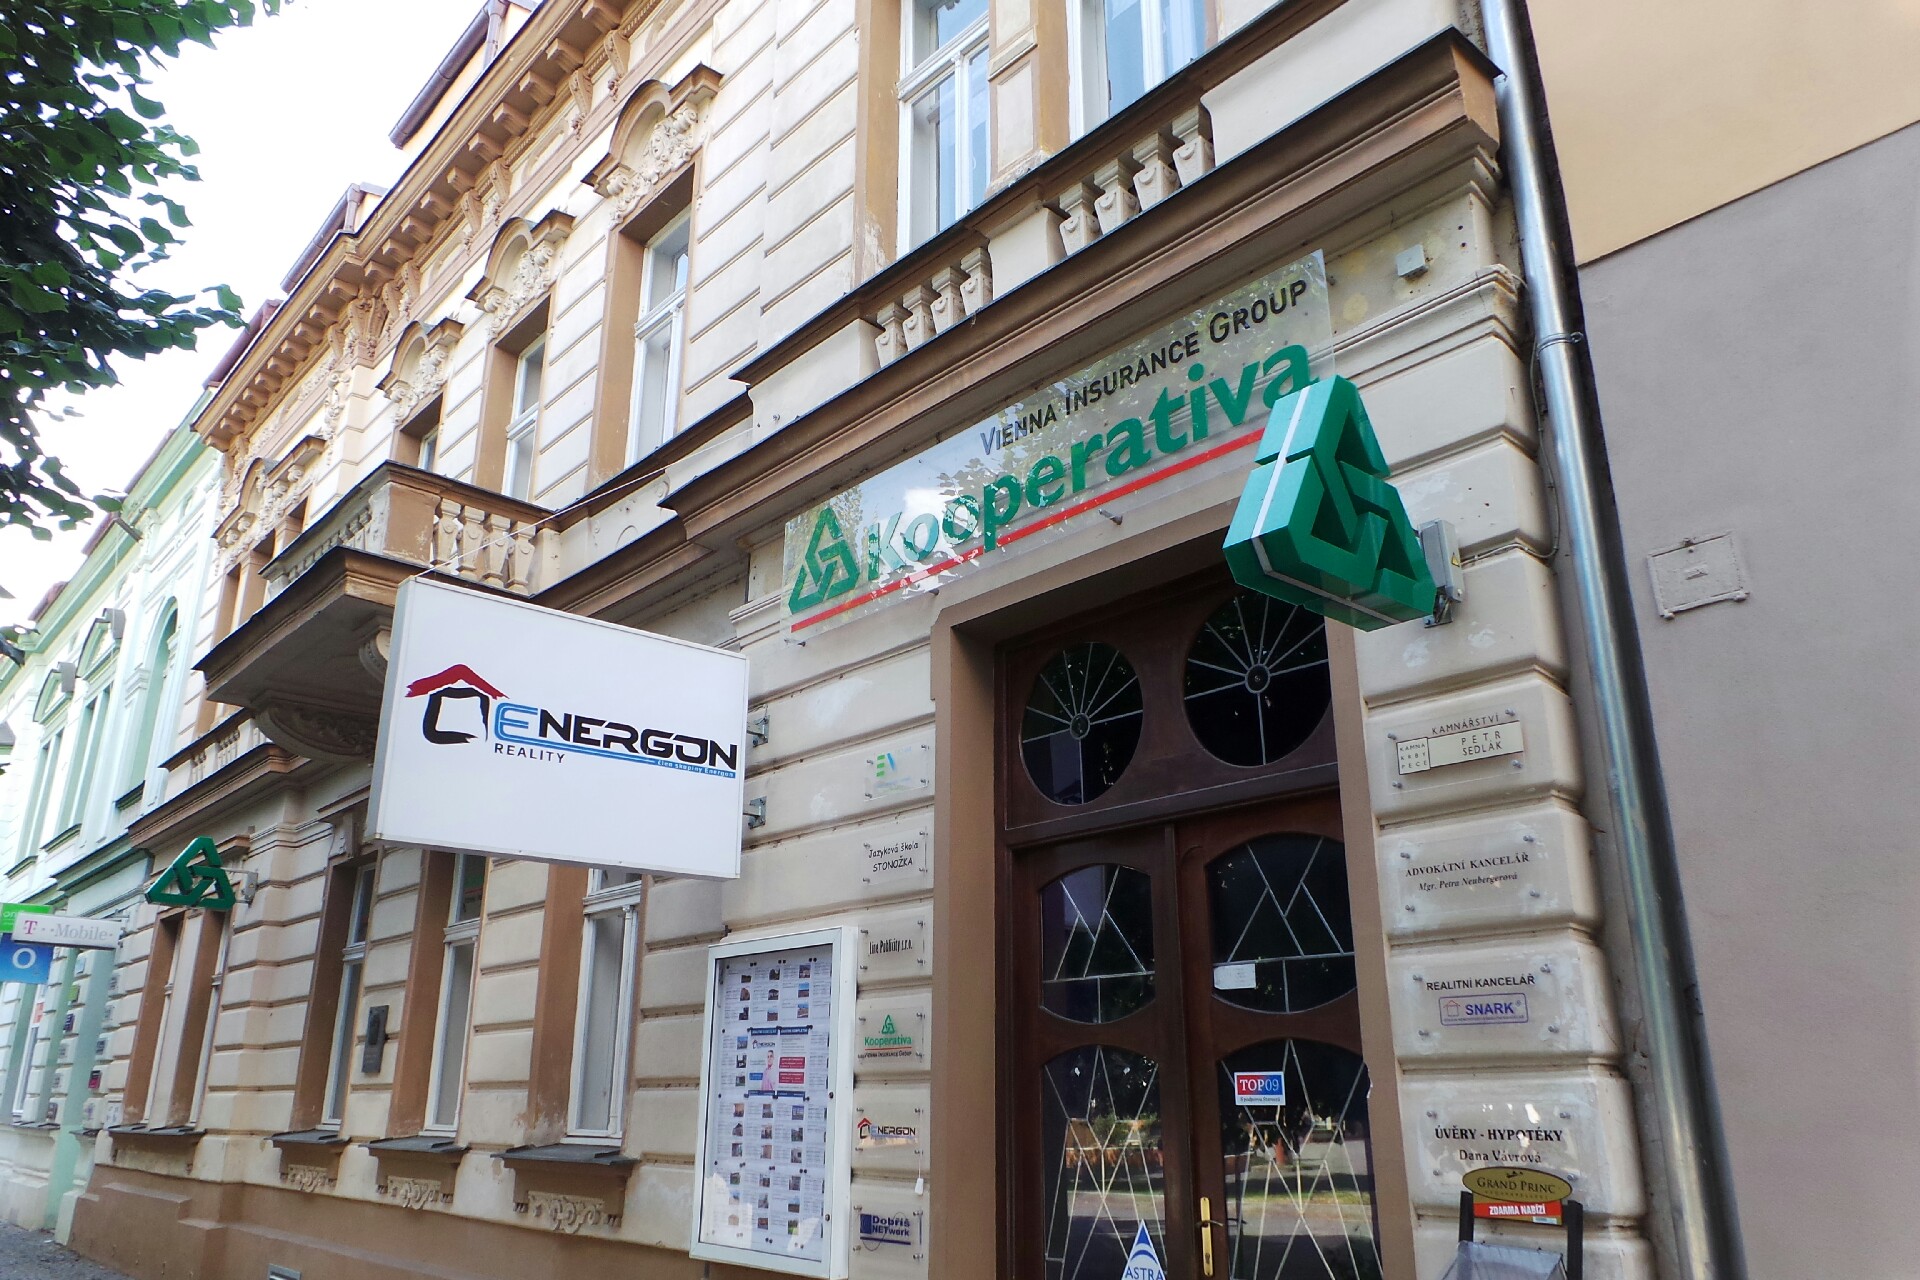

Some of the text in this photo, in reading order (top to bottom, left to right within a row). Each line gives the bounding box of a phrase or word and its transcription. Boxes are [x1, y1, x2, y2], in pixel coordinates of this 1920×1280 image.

[1065, 331, 1200, 416] INSURANCE
[1209, 279, 1307, 344] GROUP
[868, 343, 1319, 580] Kooperativa
[1431, 713, 1500, 735] KAMNÁŘSTVÍ
[493, 702, 738, 771] ENERGON
[494, 742, 566, 764] REALITY
[1462, 740, 1503, 756] SEDLÁK
[872, 855, 913, 872] STONOŽKA
[1405, 852, 1530, 877] ADVOKÁTNÍ KANCELÁŘ
[1418, 882, 1437, 892] Mgr.
[1439, 880, 1460, 889] Petra
[1426, 973, 1536, 991] REALITNÍ KANCELÁŘ
[1465, 1002, 1515, 1016] SNARK
[864, 1035, 913, 1048] Kooperativa
[871, 1124, 916, 1137] ENERGON
[1434, 1125, 1477, 1140] ÚVĚRY
[1487, 1126, 1563, 1142] HYPOTÉKY
[1459, 1149, 1542, 1163] Dana Vávrová
[1476, 1177, 1556, 1194] GRAND PRINC
[1488, 1203, 1547, 1216] ZDARMA NABÍZÍ
[872, 1225, 910, 1237] NETwork
[1124, 1265, 1165, 1280] ASTRA
